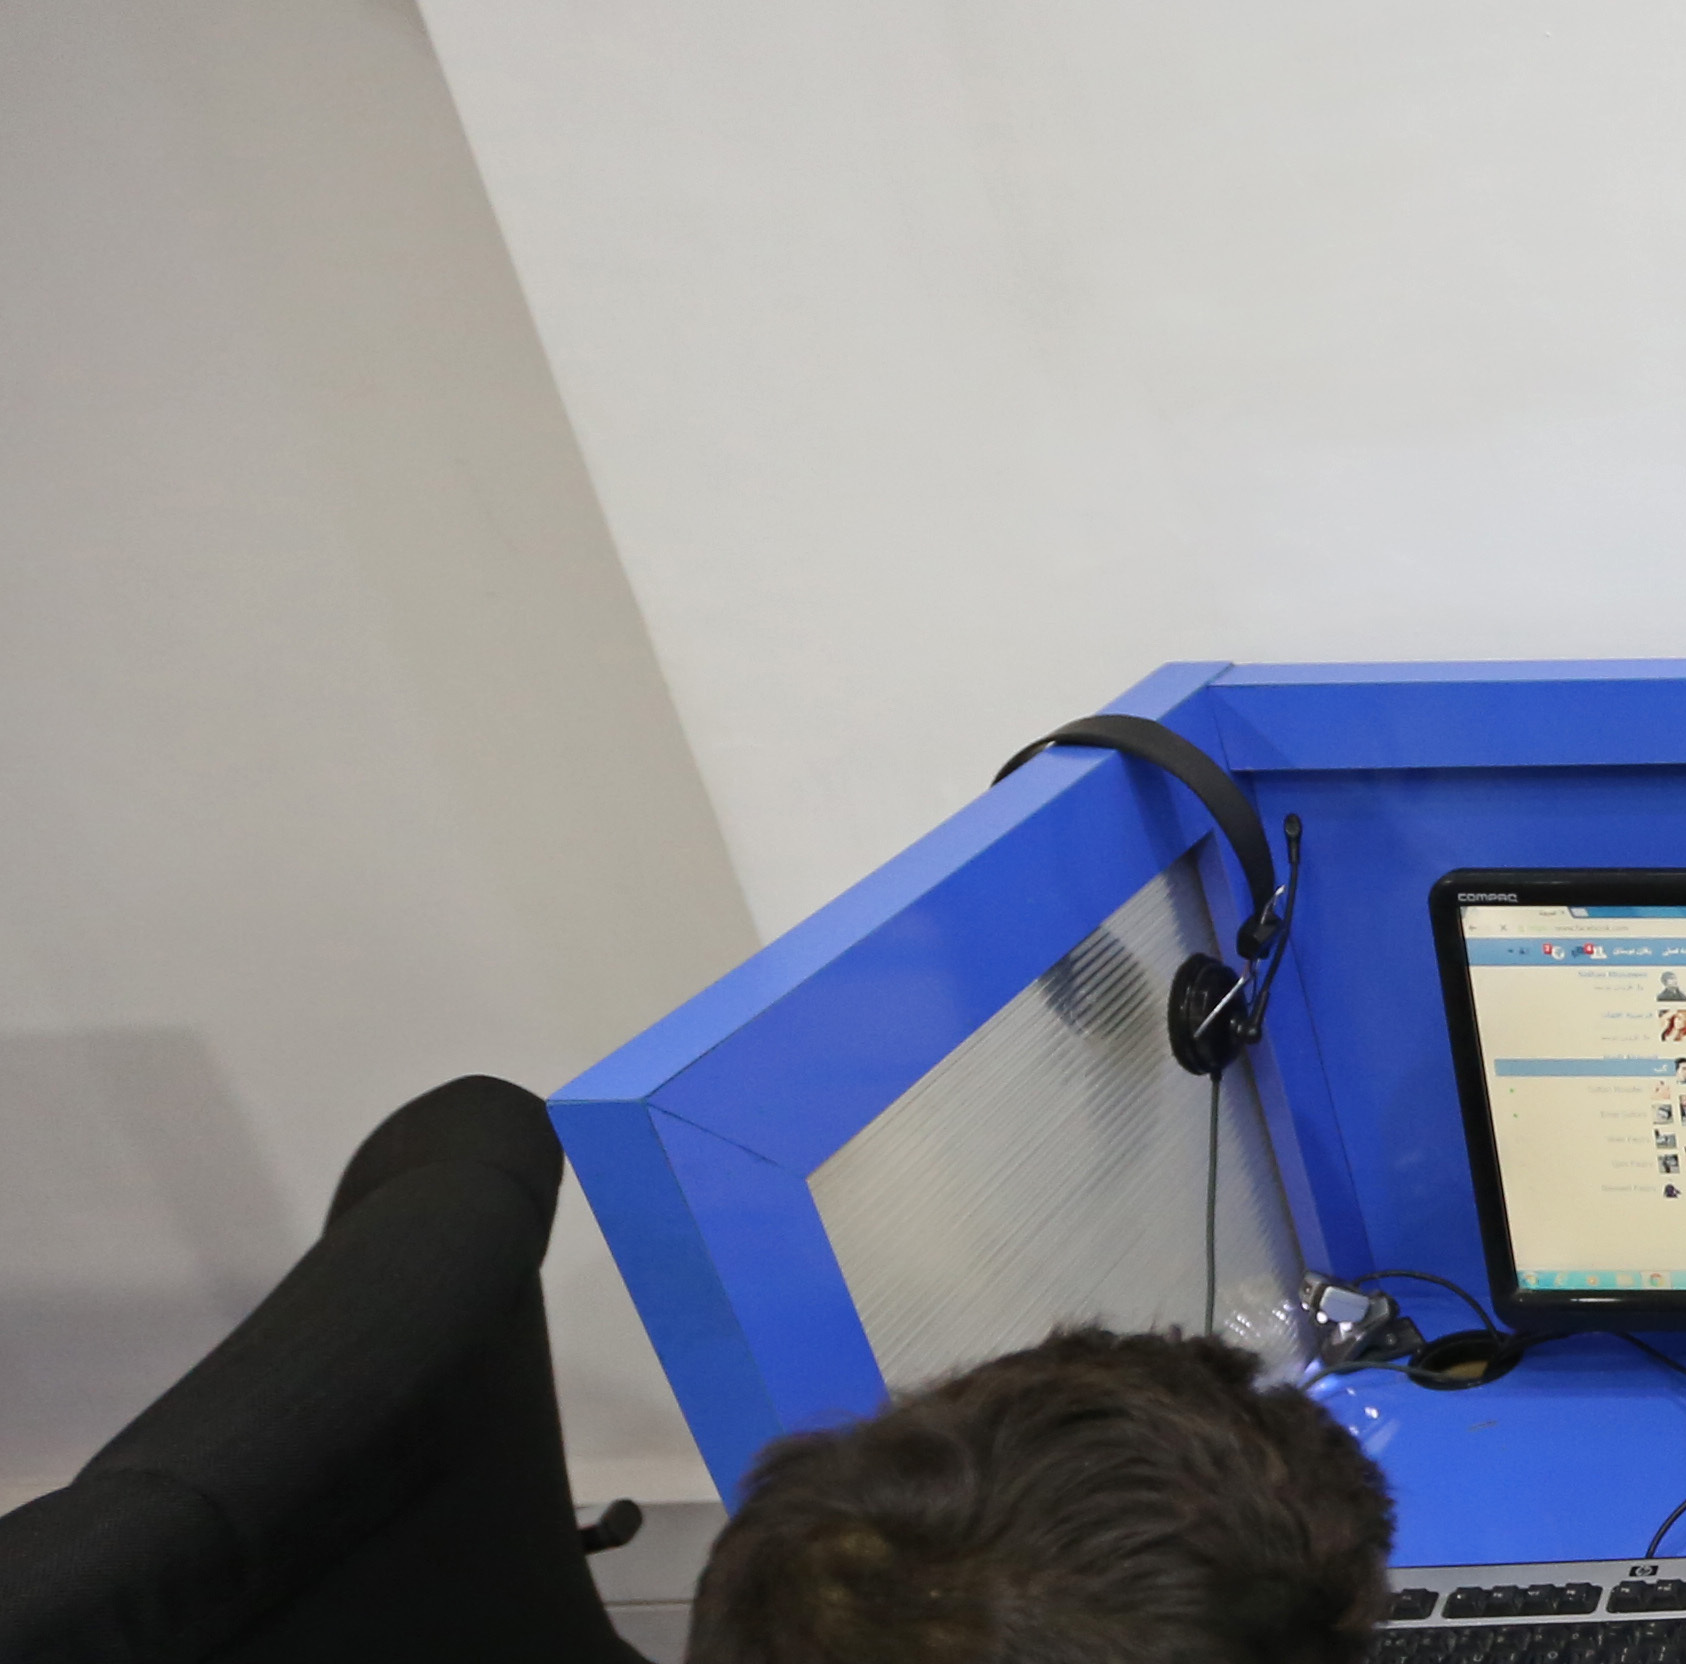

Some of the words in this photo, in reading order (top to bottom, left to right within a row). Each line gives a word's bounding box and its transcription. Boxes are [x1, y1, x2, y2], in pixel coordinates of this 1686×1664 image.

[1458, 893, 1519, 903] COMPAQ
[1400, 1655, 1408, 1664] T
[1472, 1654, 1484, 1662] U
